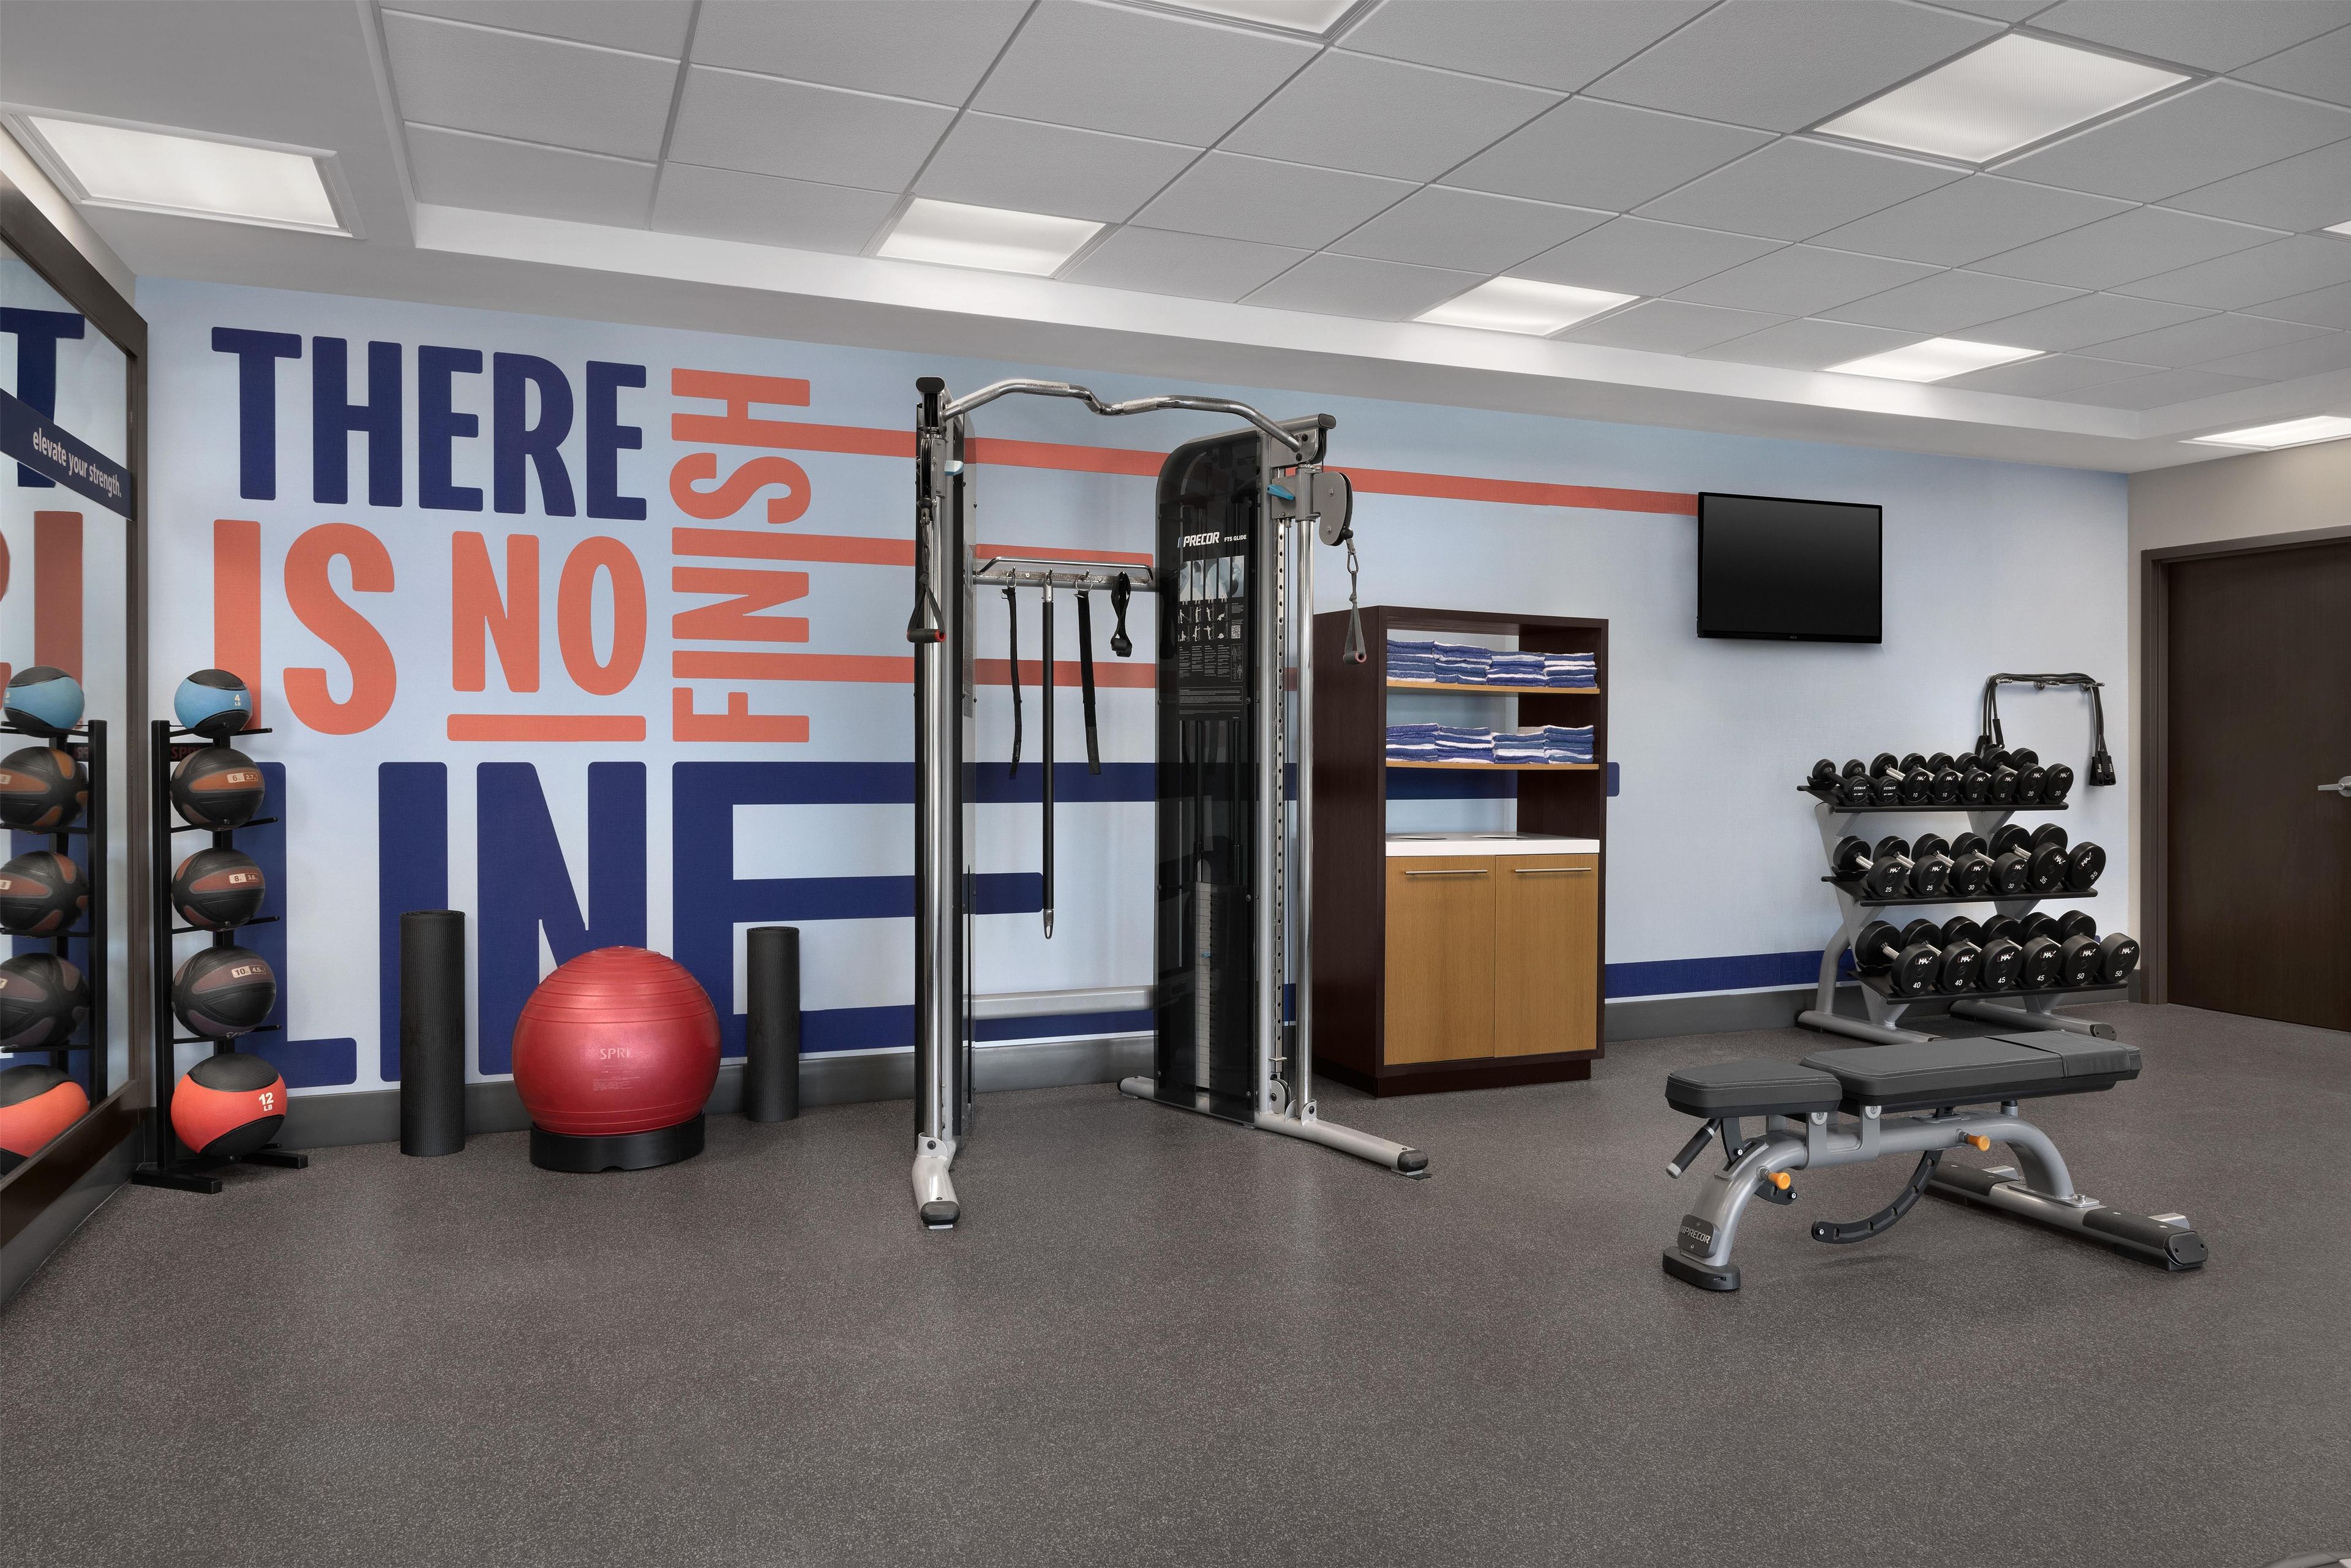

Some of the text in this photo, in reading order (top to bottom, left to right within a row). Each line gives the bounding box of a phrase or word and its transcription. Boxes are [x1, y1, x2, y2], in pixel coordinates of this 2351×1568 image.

[211, 326, 647, 520] THERE
[33, 427, 121, 498] elevate your strength.
[1183, 531, 1220, 547] PRECOR
[669, 367, 811, 743] FINISH
[214, 519, 396, 735] IS
[452, 531, 647, 696] NO
[2090, 871, 2098, 880] 35
[600, 1048, 629, 1060] SPRI
[258, 1092, 274, 1105] 12
[1684, 1227, 1711, 1244] PRECOR
